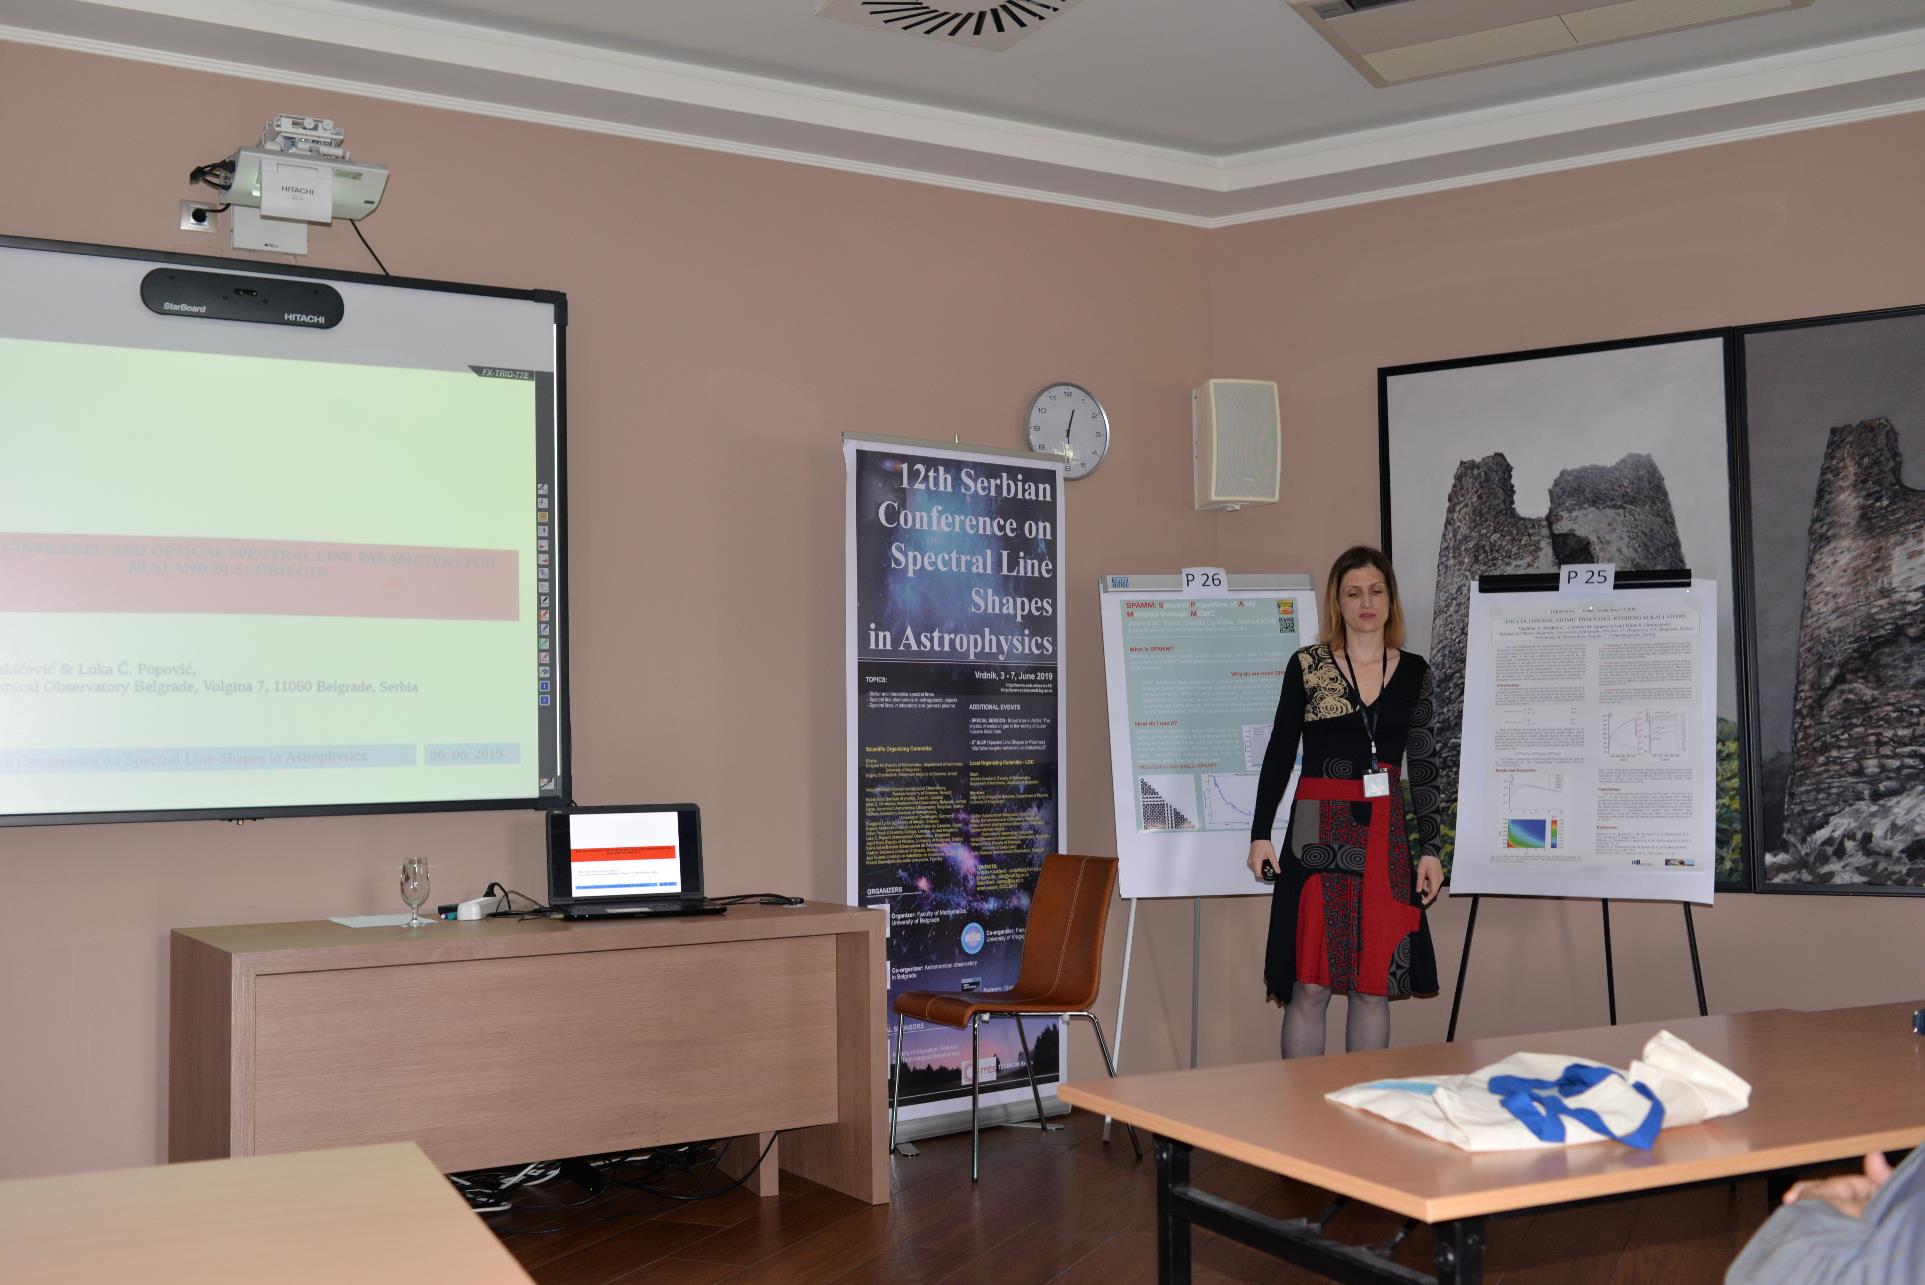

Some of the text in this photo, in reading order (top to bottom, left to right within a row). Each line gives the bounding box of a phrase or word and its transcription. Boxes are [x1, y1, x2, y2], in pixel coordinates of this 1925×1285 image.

[281, 185, 314, 195] HITACHI
[163, 302, 206, 313] StarBoard
[284, 313, 325, 324] HITACHI
[900, 463, 1053, 502] 12th Serbian
[878, 501, 1053, 540] Conference on
[316, 552, 353, 563] LINE
[358, 552, 462, 568] PARAMETERS
[464, 556, 495, 569] FOR
[891, 542, 1053, 578] Spectral Line
[174, 562, 209, 575] AND
[255, 564, 328, 577] OBJECTS
[1567, 569, 1608, 584] P 25
[1185, 573, 1222, 587] P 26
[971, 587, 1053, 623] Shapes
[868, 623, 1053, 661] in Astrophysics
[78, 662, 113, 676] Luka
[138, 662, 197, 680] Popović,
[974, 671, 999, 681] Vrdnik,
[1019, 672, 1036, 681] June
[1037, 672, 1053, 681] 2019
[43, 680, 130, 697] Observatory
[134, 679, 199, 697] Belgrade,
[203, 680, 254, 697] Volgina
[257, 680, 271, 695] 7,
[273, 680, 313, 694] 11060
[316, 680, 377, 697] Belgrade,
[379, 681, 419, 694] Serbia
[125, 751, 181, 769] Spectral
[184, 751, 216, 765] Line
[218, 751, 266, 769] Shapes
[268, 751, 284, 764] in
[286, 750, 367, 768] Astrophysics
[866, 886, 903, 895] ORGANIZERS
